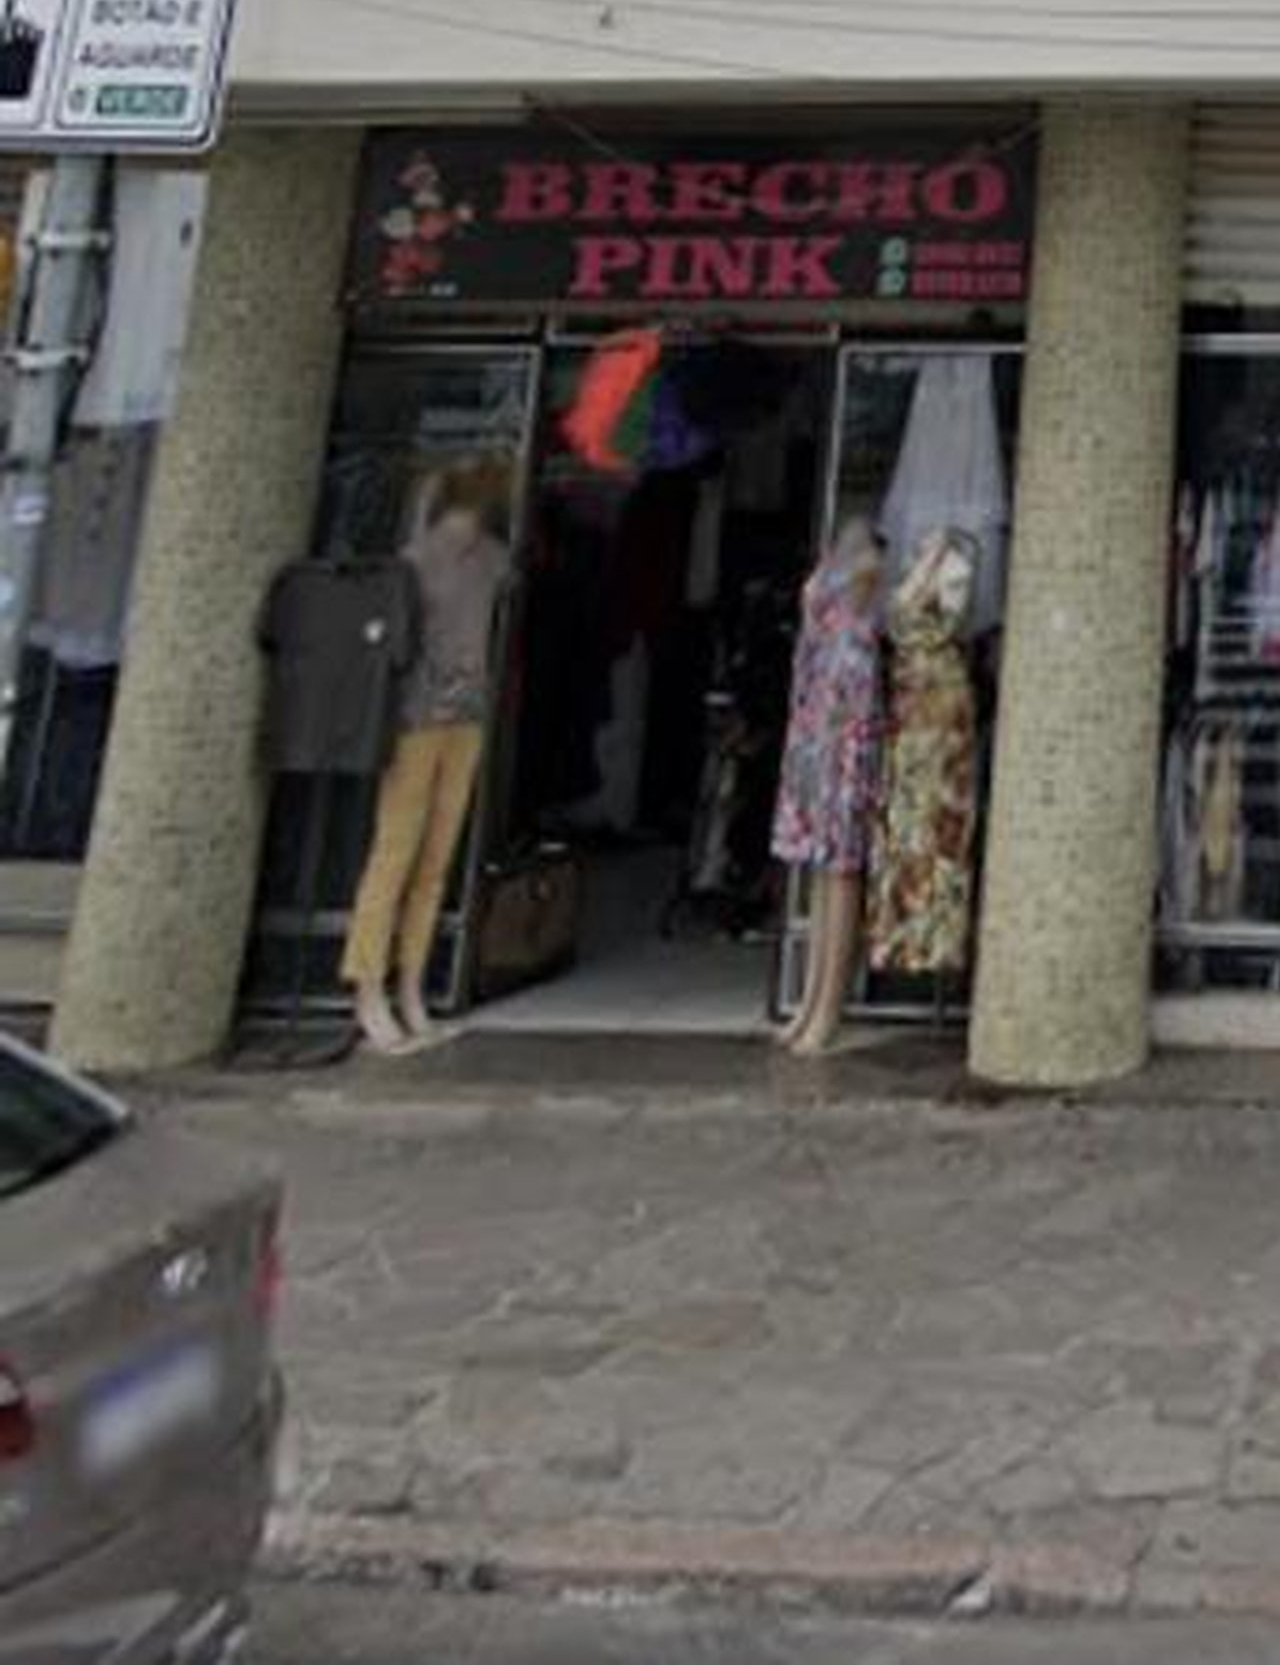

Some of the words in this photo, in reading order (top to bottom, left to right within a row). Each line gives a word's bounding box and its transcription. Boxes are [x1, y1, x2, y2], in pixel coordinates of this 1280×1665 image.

[78, 44, 199, 69] AGUARDE
[498, 144, 1009, 222] BRECHÓ
[566, 234, 846, 295] PINK
